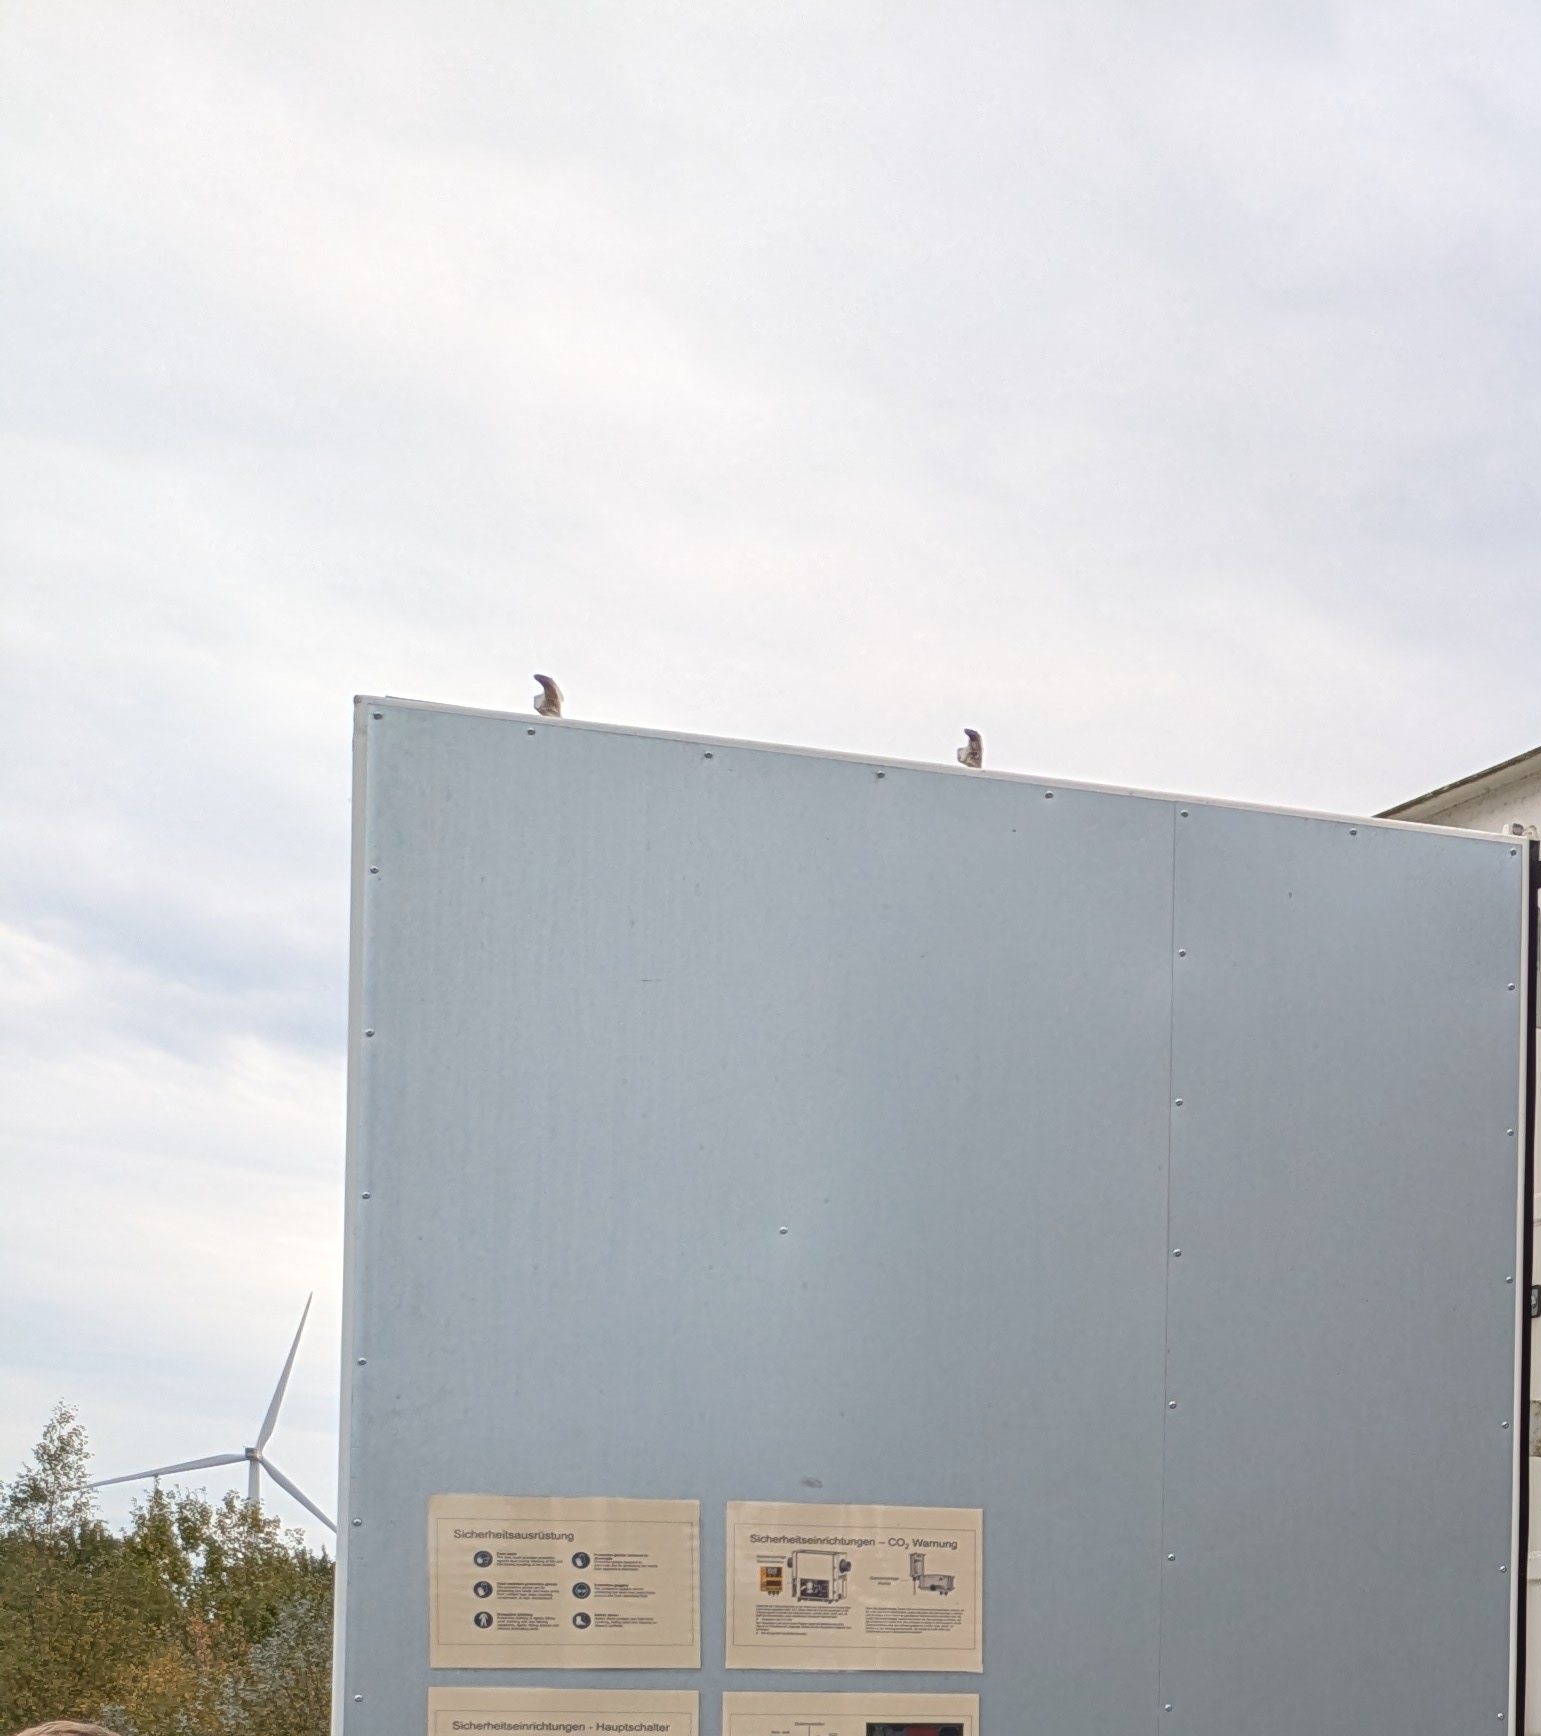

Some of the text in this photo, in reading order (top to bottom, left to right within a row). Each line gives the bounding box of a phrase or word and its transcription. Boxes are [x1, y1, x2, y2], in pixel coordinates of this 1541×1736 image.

[453, 1528, 575, 1543] Sicherheitsausrüstung
[750, 1534, 876, 1549] Sicherheitseinrichtungen
[452, 1720, 586, 1734] Sicherheitseinrichtungen
[596, 1722, 671, 1734] Hauptschalter
